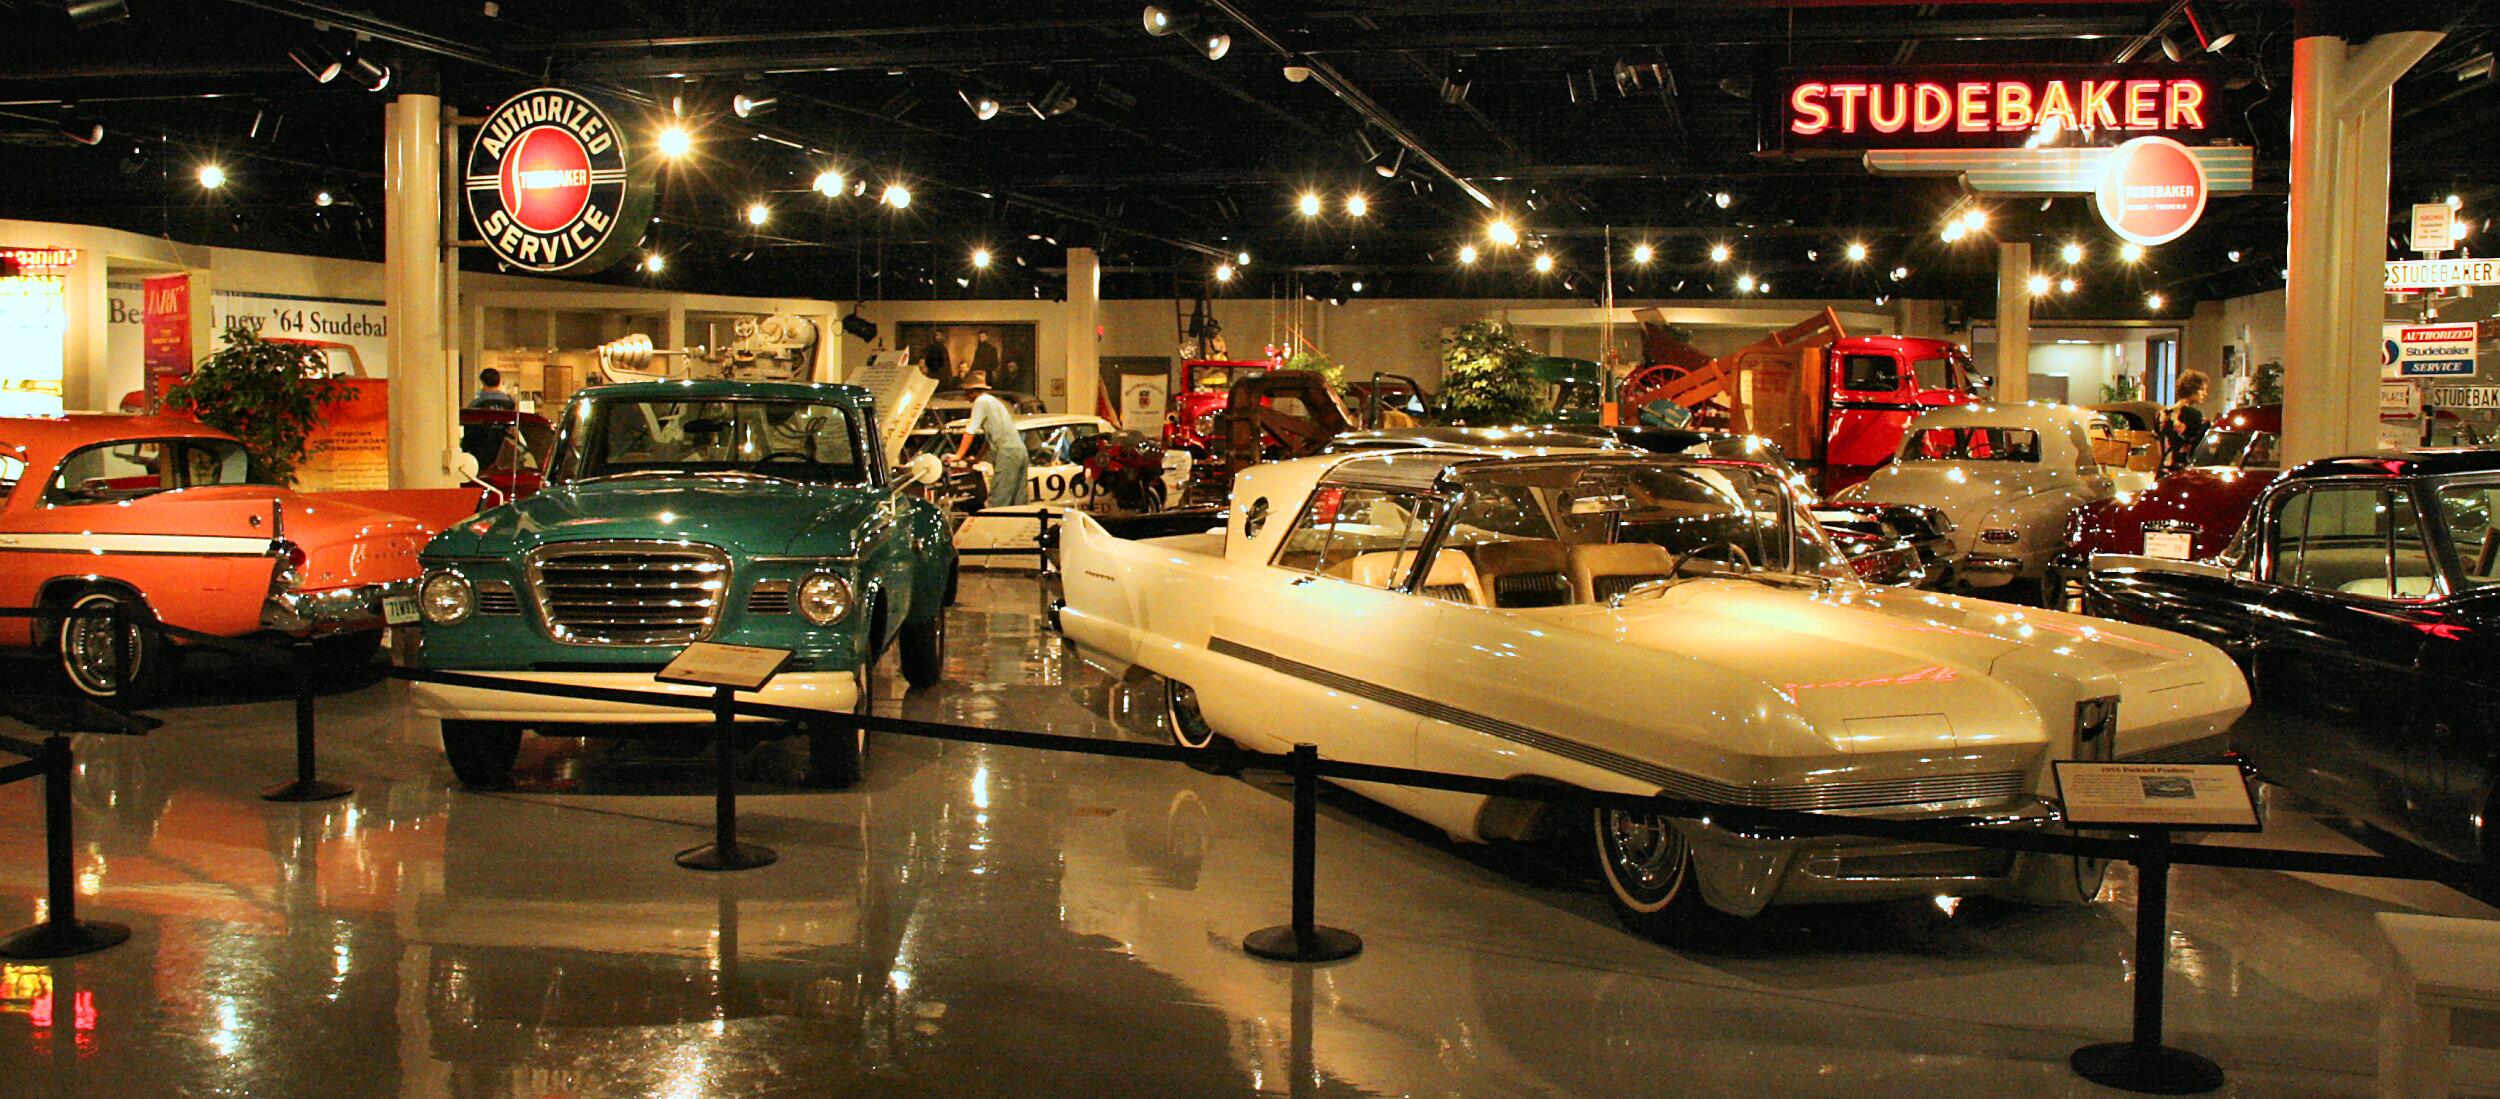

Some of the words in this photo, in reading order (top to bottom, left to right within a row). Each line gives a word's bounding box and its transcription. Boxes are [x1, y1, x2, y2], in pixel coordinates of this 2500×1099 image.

[1790, 79, 2206, 134] STUDEBAKER
[482, 96, 612, 160] AUTHORIZED
[483, 205, 610, 263] SERVICE
[2391, 263, 2492, 284] STUDEBAKER
[273, 307, 304, 333] '64
[2403, 329, 2473, 341] AUTHORIZED
[2406, 346, 2470, 357] Studebaker
[2412, 362, 2462, 372] SERVICE
